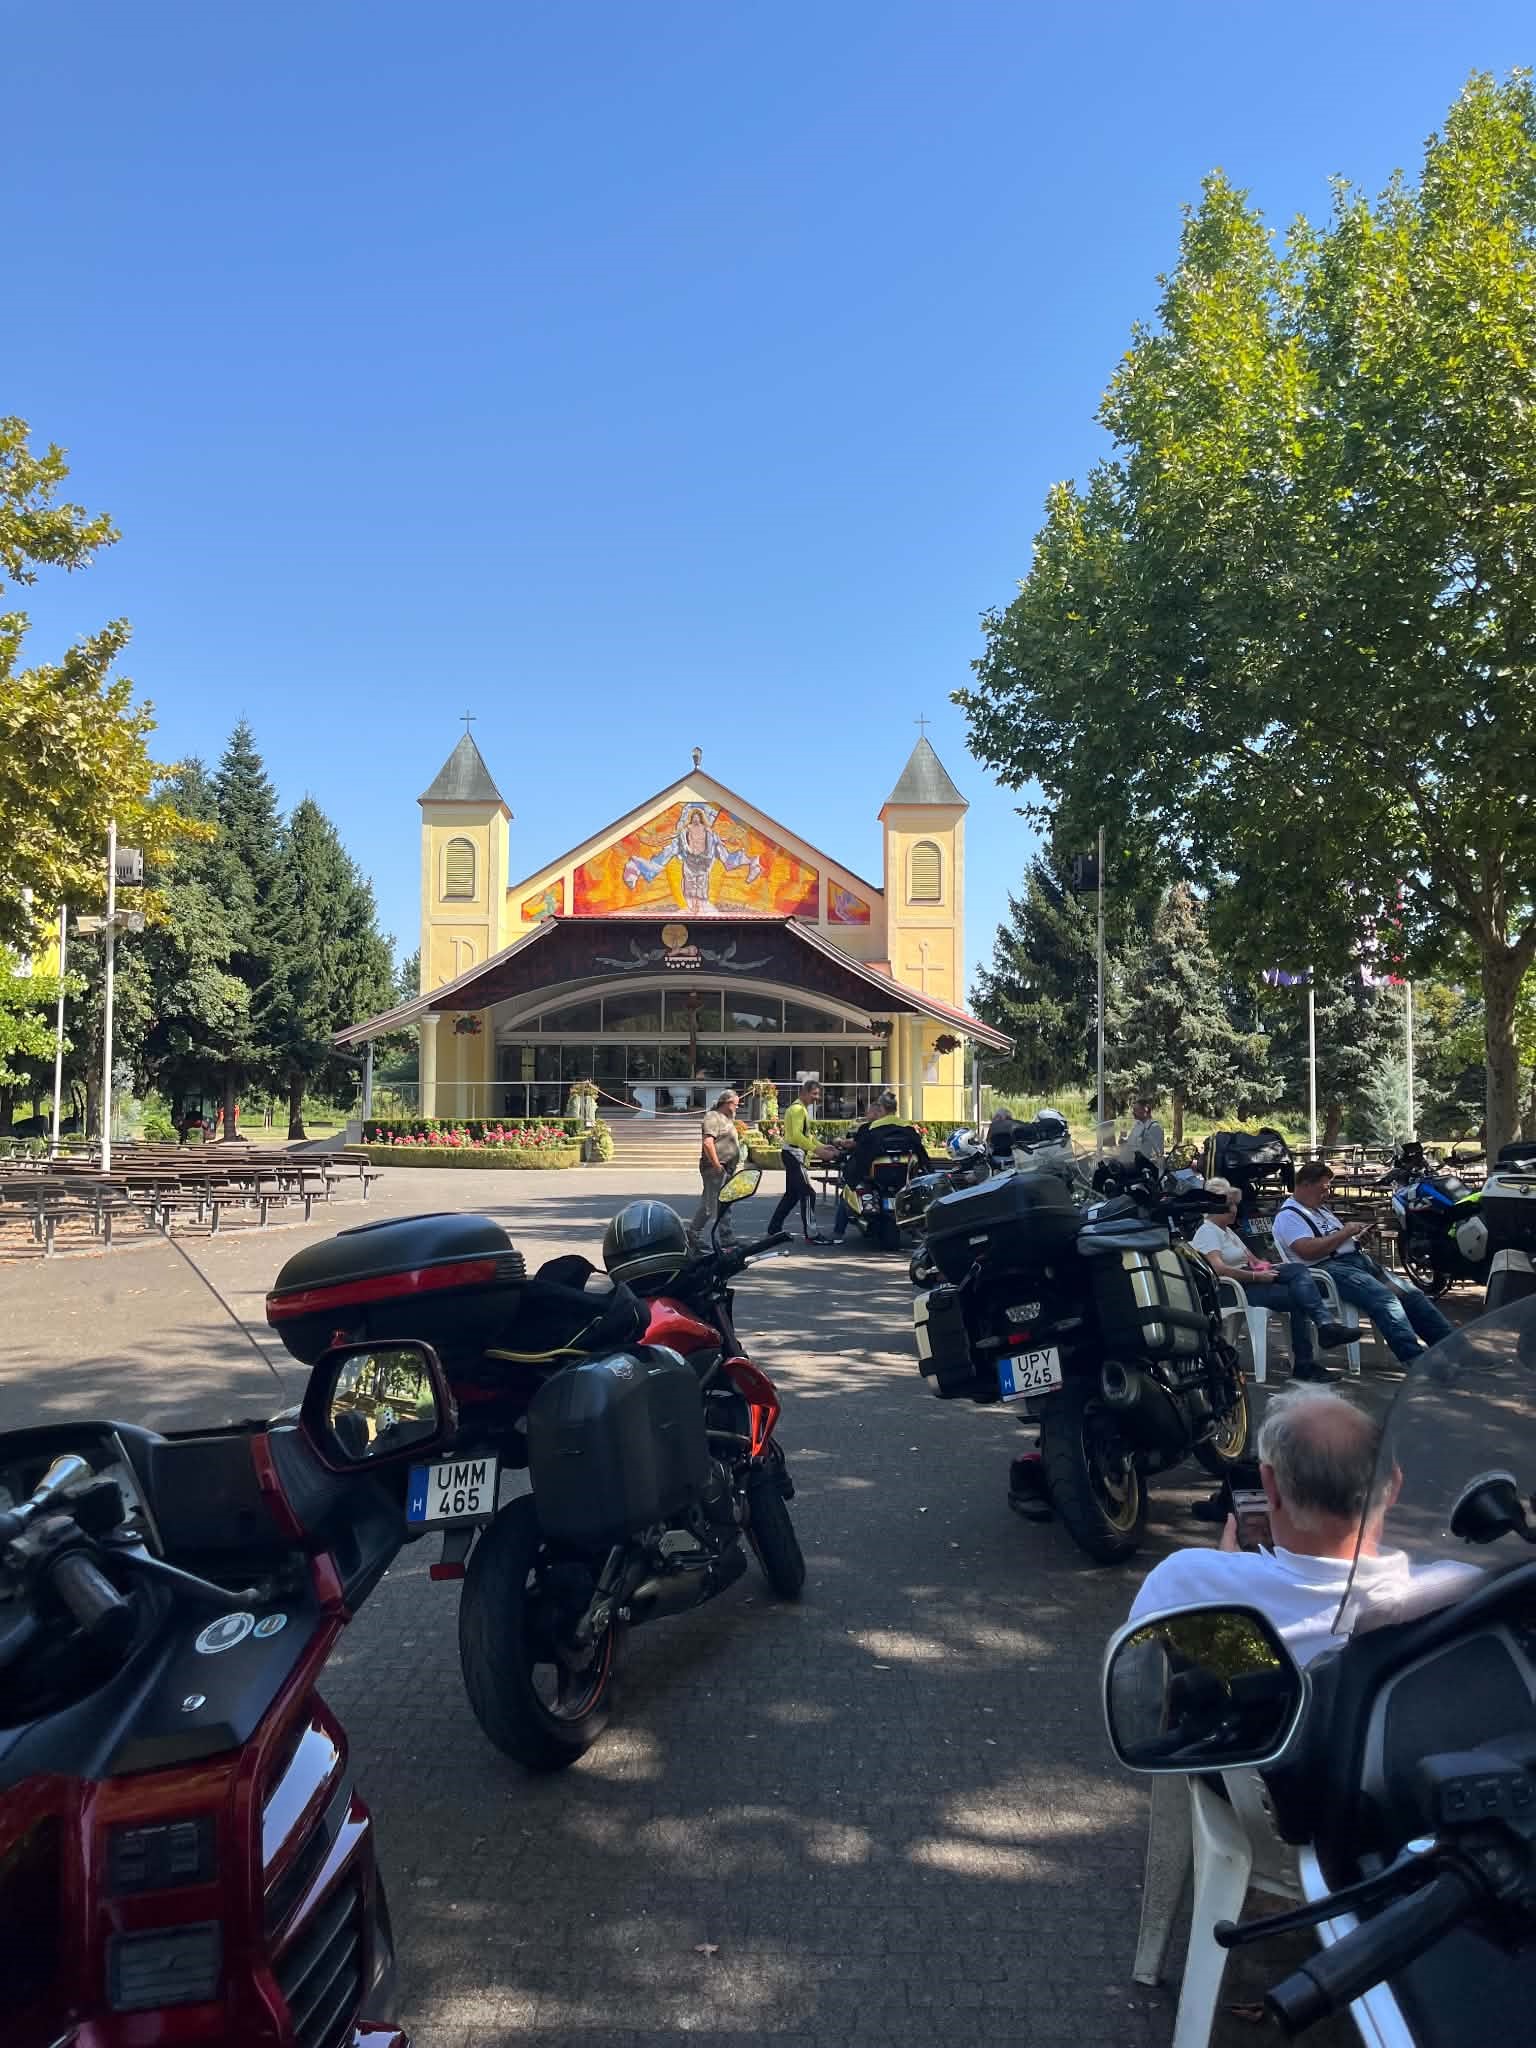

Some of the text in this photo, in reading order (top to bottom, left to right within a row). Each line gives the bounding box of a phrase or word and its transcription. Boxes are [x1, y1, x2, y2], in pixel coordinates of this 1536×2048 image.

[1017, 1350, 1051, 1371] UPY
[1004, 1378, 1012, 1390] H
[1023, 1368, 1052, 1388] 245
[437, 1461, 486, 1489] UMM
[412, 1498, 422, 1513] H
[439, 1488, 480, 1514] 465
